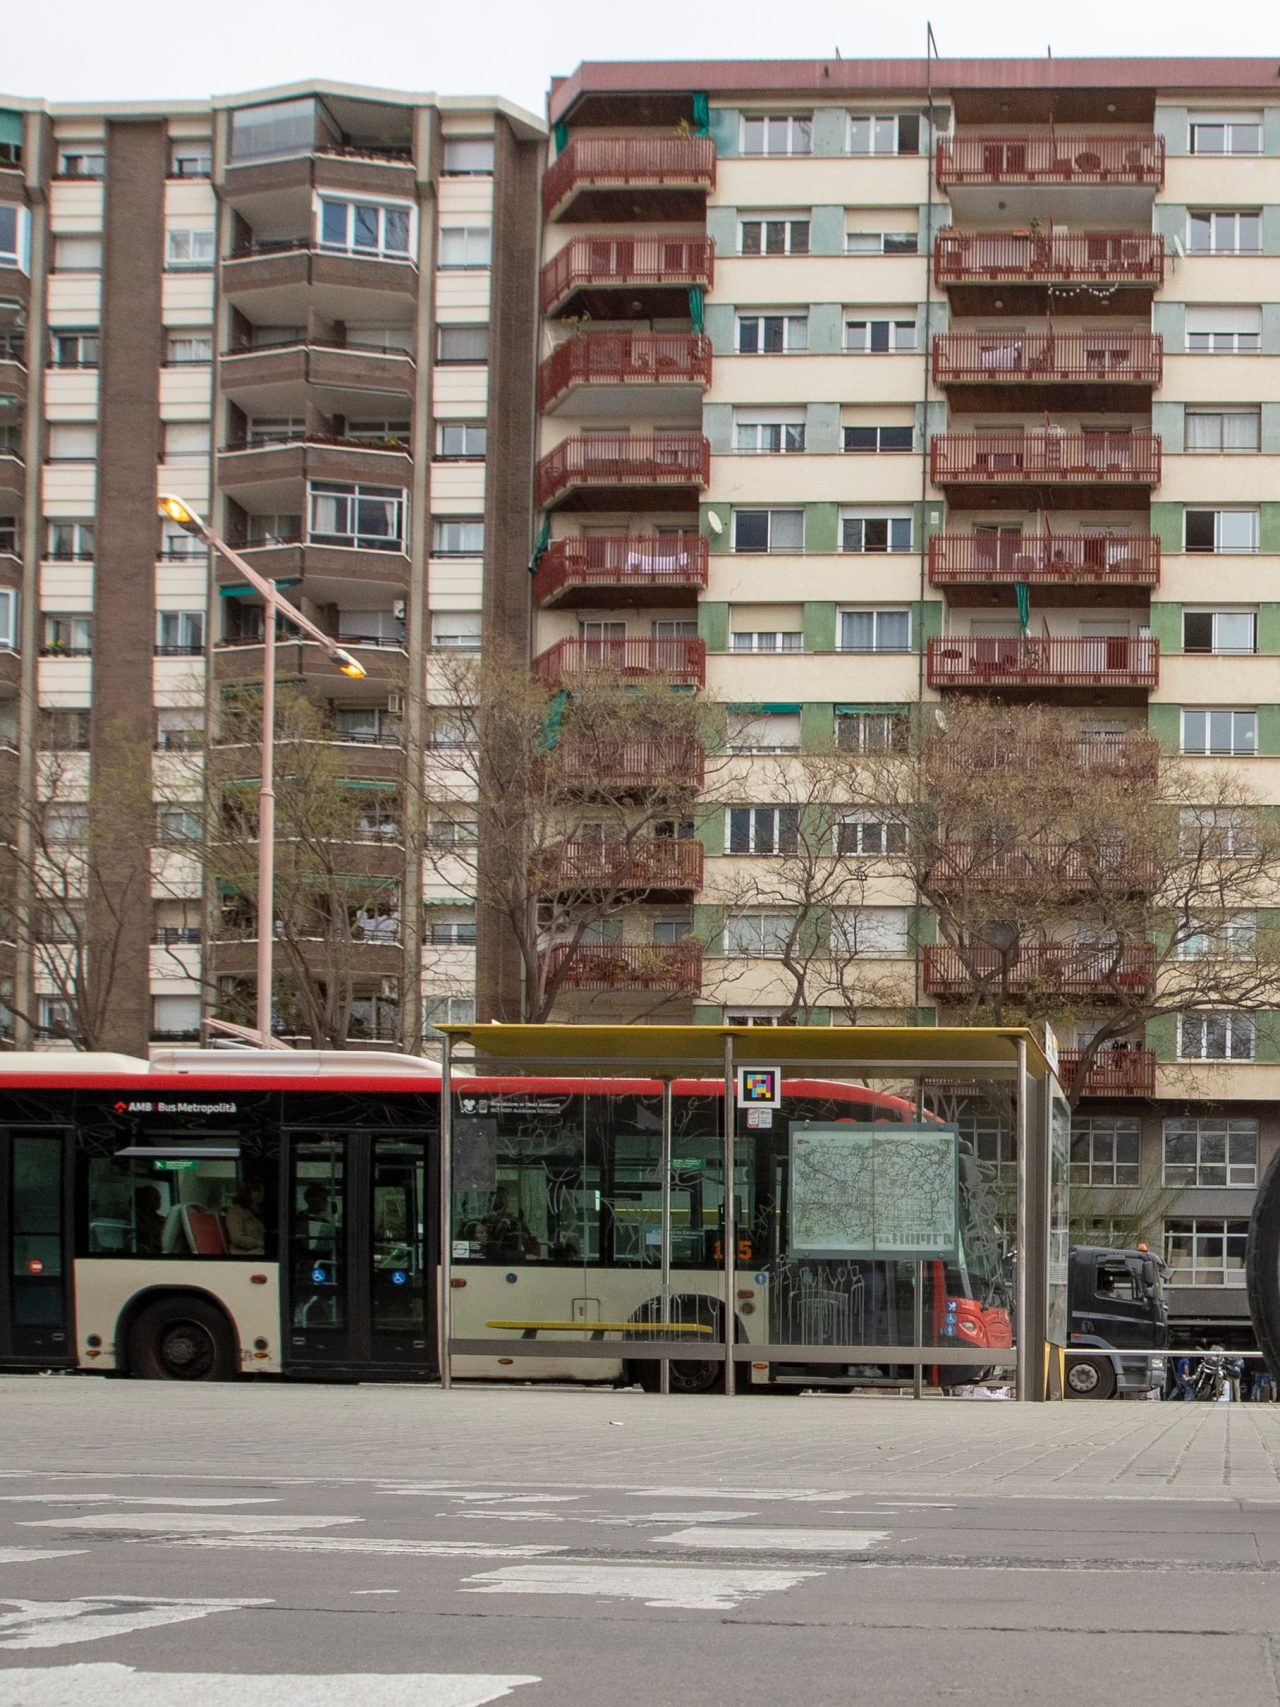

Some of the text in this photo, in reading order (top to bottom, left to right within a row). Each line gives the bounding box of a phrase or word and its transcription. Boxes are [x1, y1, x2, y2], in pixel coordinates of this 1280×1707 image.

[128, 1102, 237, 1114] AMB Bus Metropolità
[713, 1239, 754, 1260] 15
